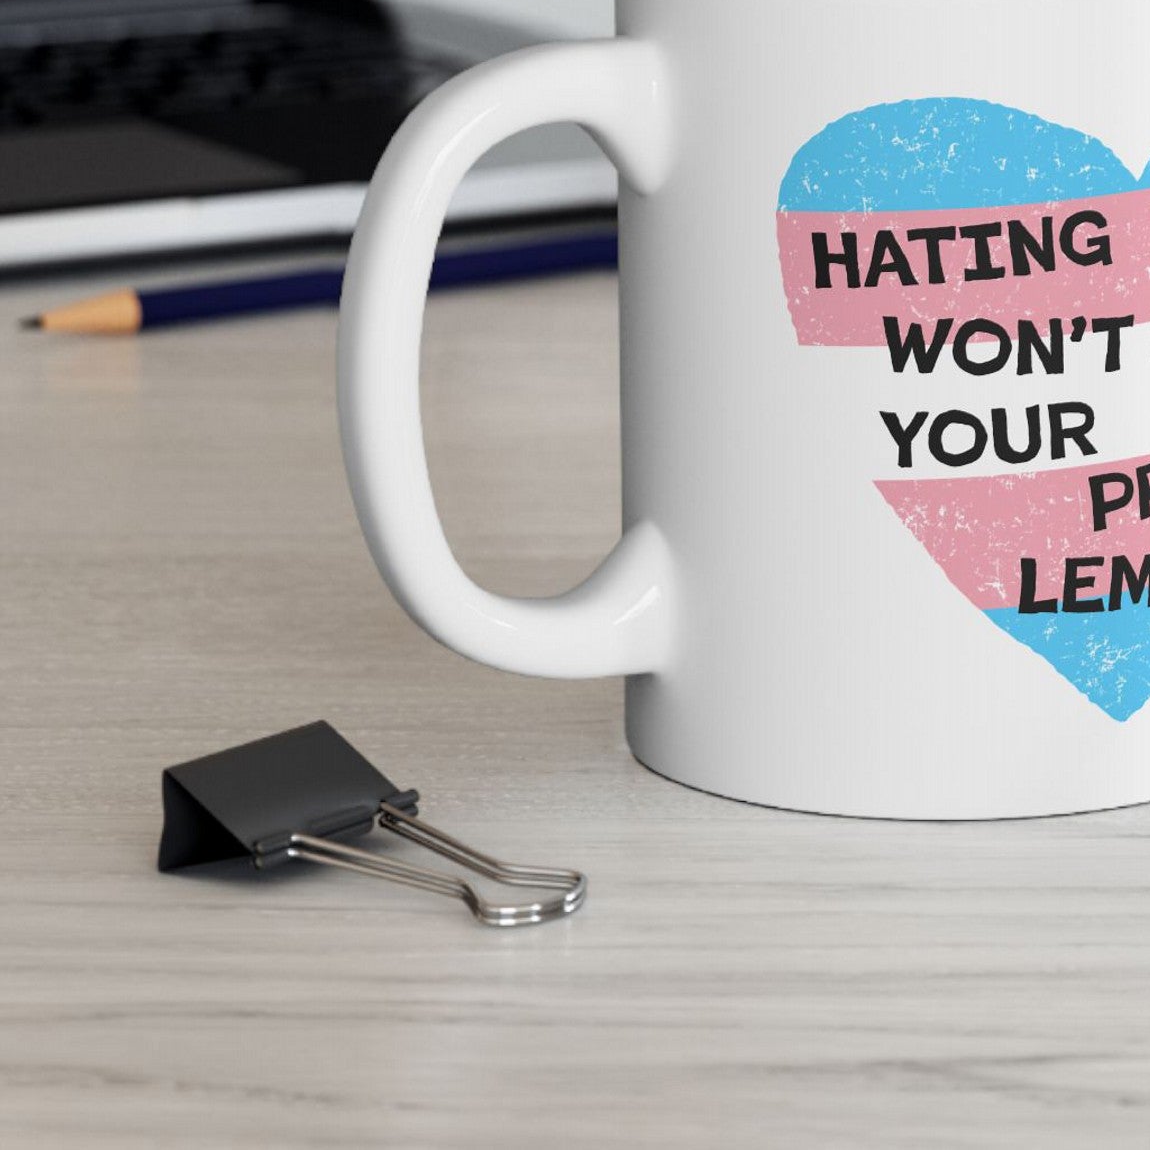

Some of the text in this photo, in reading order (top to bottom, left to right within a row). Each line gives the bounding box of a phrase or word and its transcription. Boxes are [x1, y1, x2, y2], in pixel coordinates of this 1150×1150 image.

[811, 210, 1113, 289] HATING
[882, 314, 1134, 376] WON'T
[879, 401, 1098, 468] YOUR
